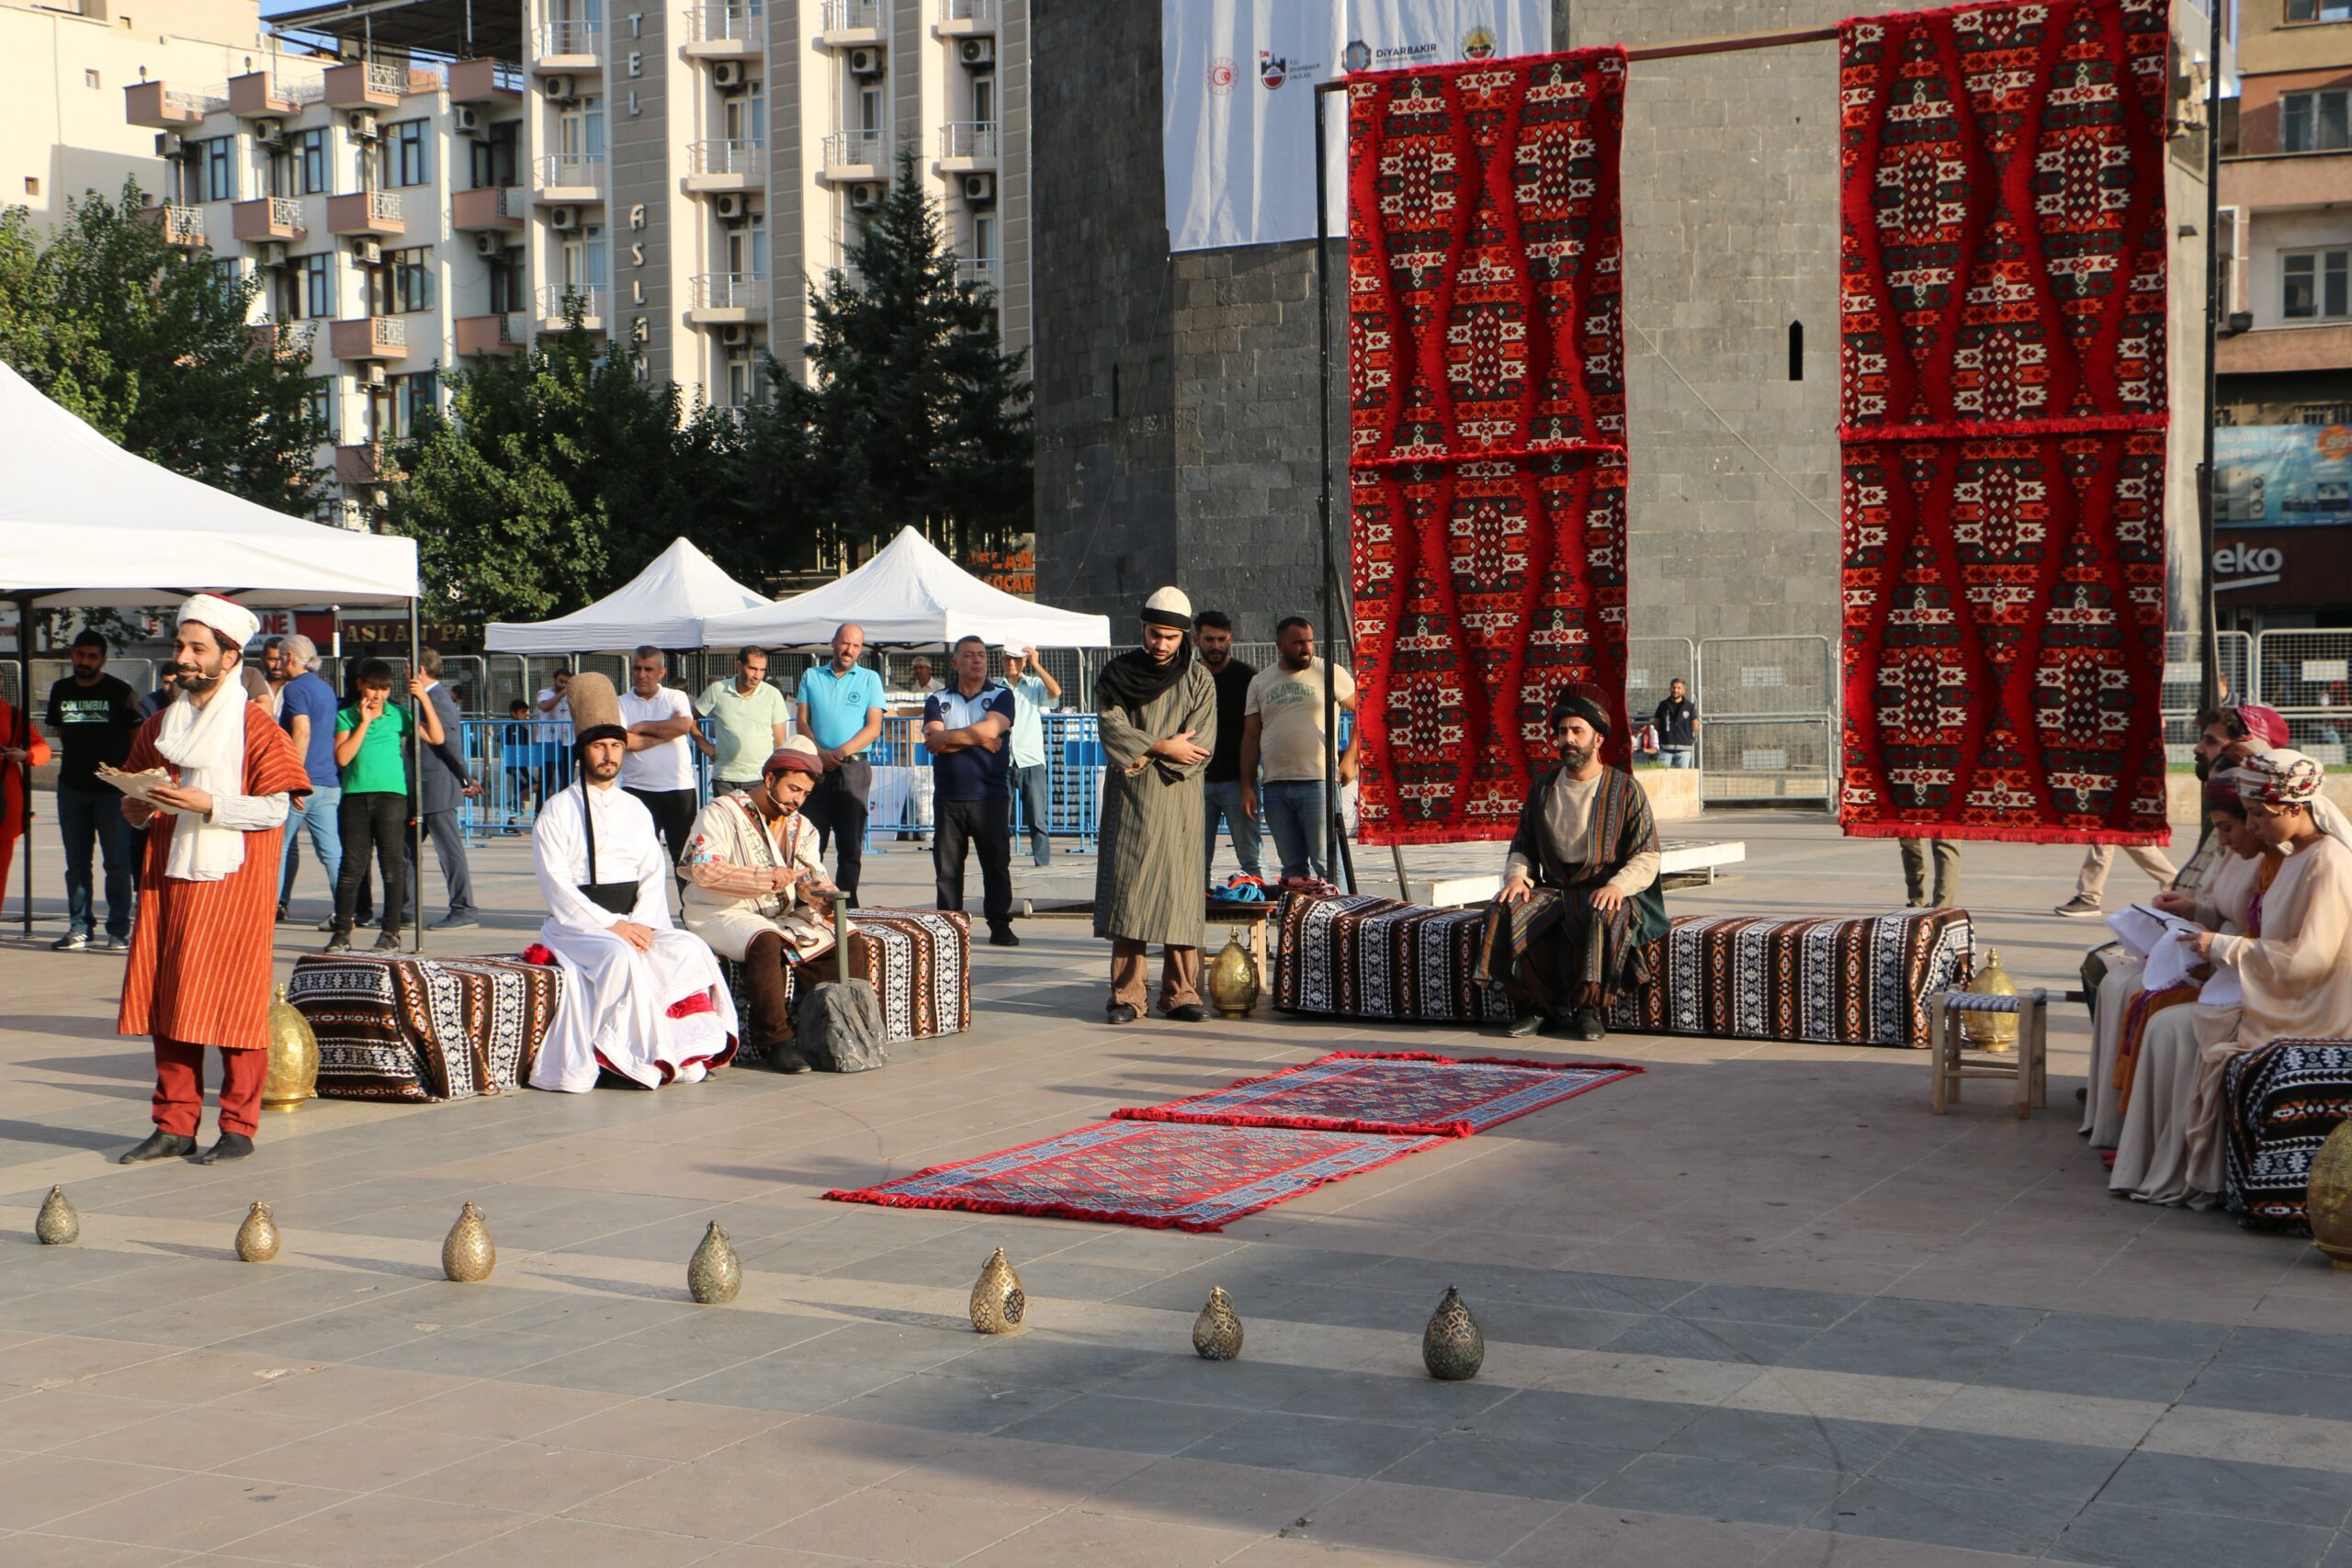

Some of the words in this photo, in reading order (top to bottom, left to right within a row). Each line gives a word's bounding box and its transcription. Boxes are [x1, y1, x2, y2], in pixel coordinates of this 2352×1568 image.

[630, 204, 649, 382] ASLAN
[259, 614, 288, 635] NE
[61, 700, 109, 712] COLUMBIA
